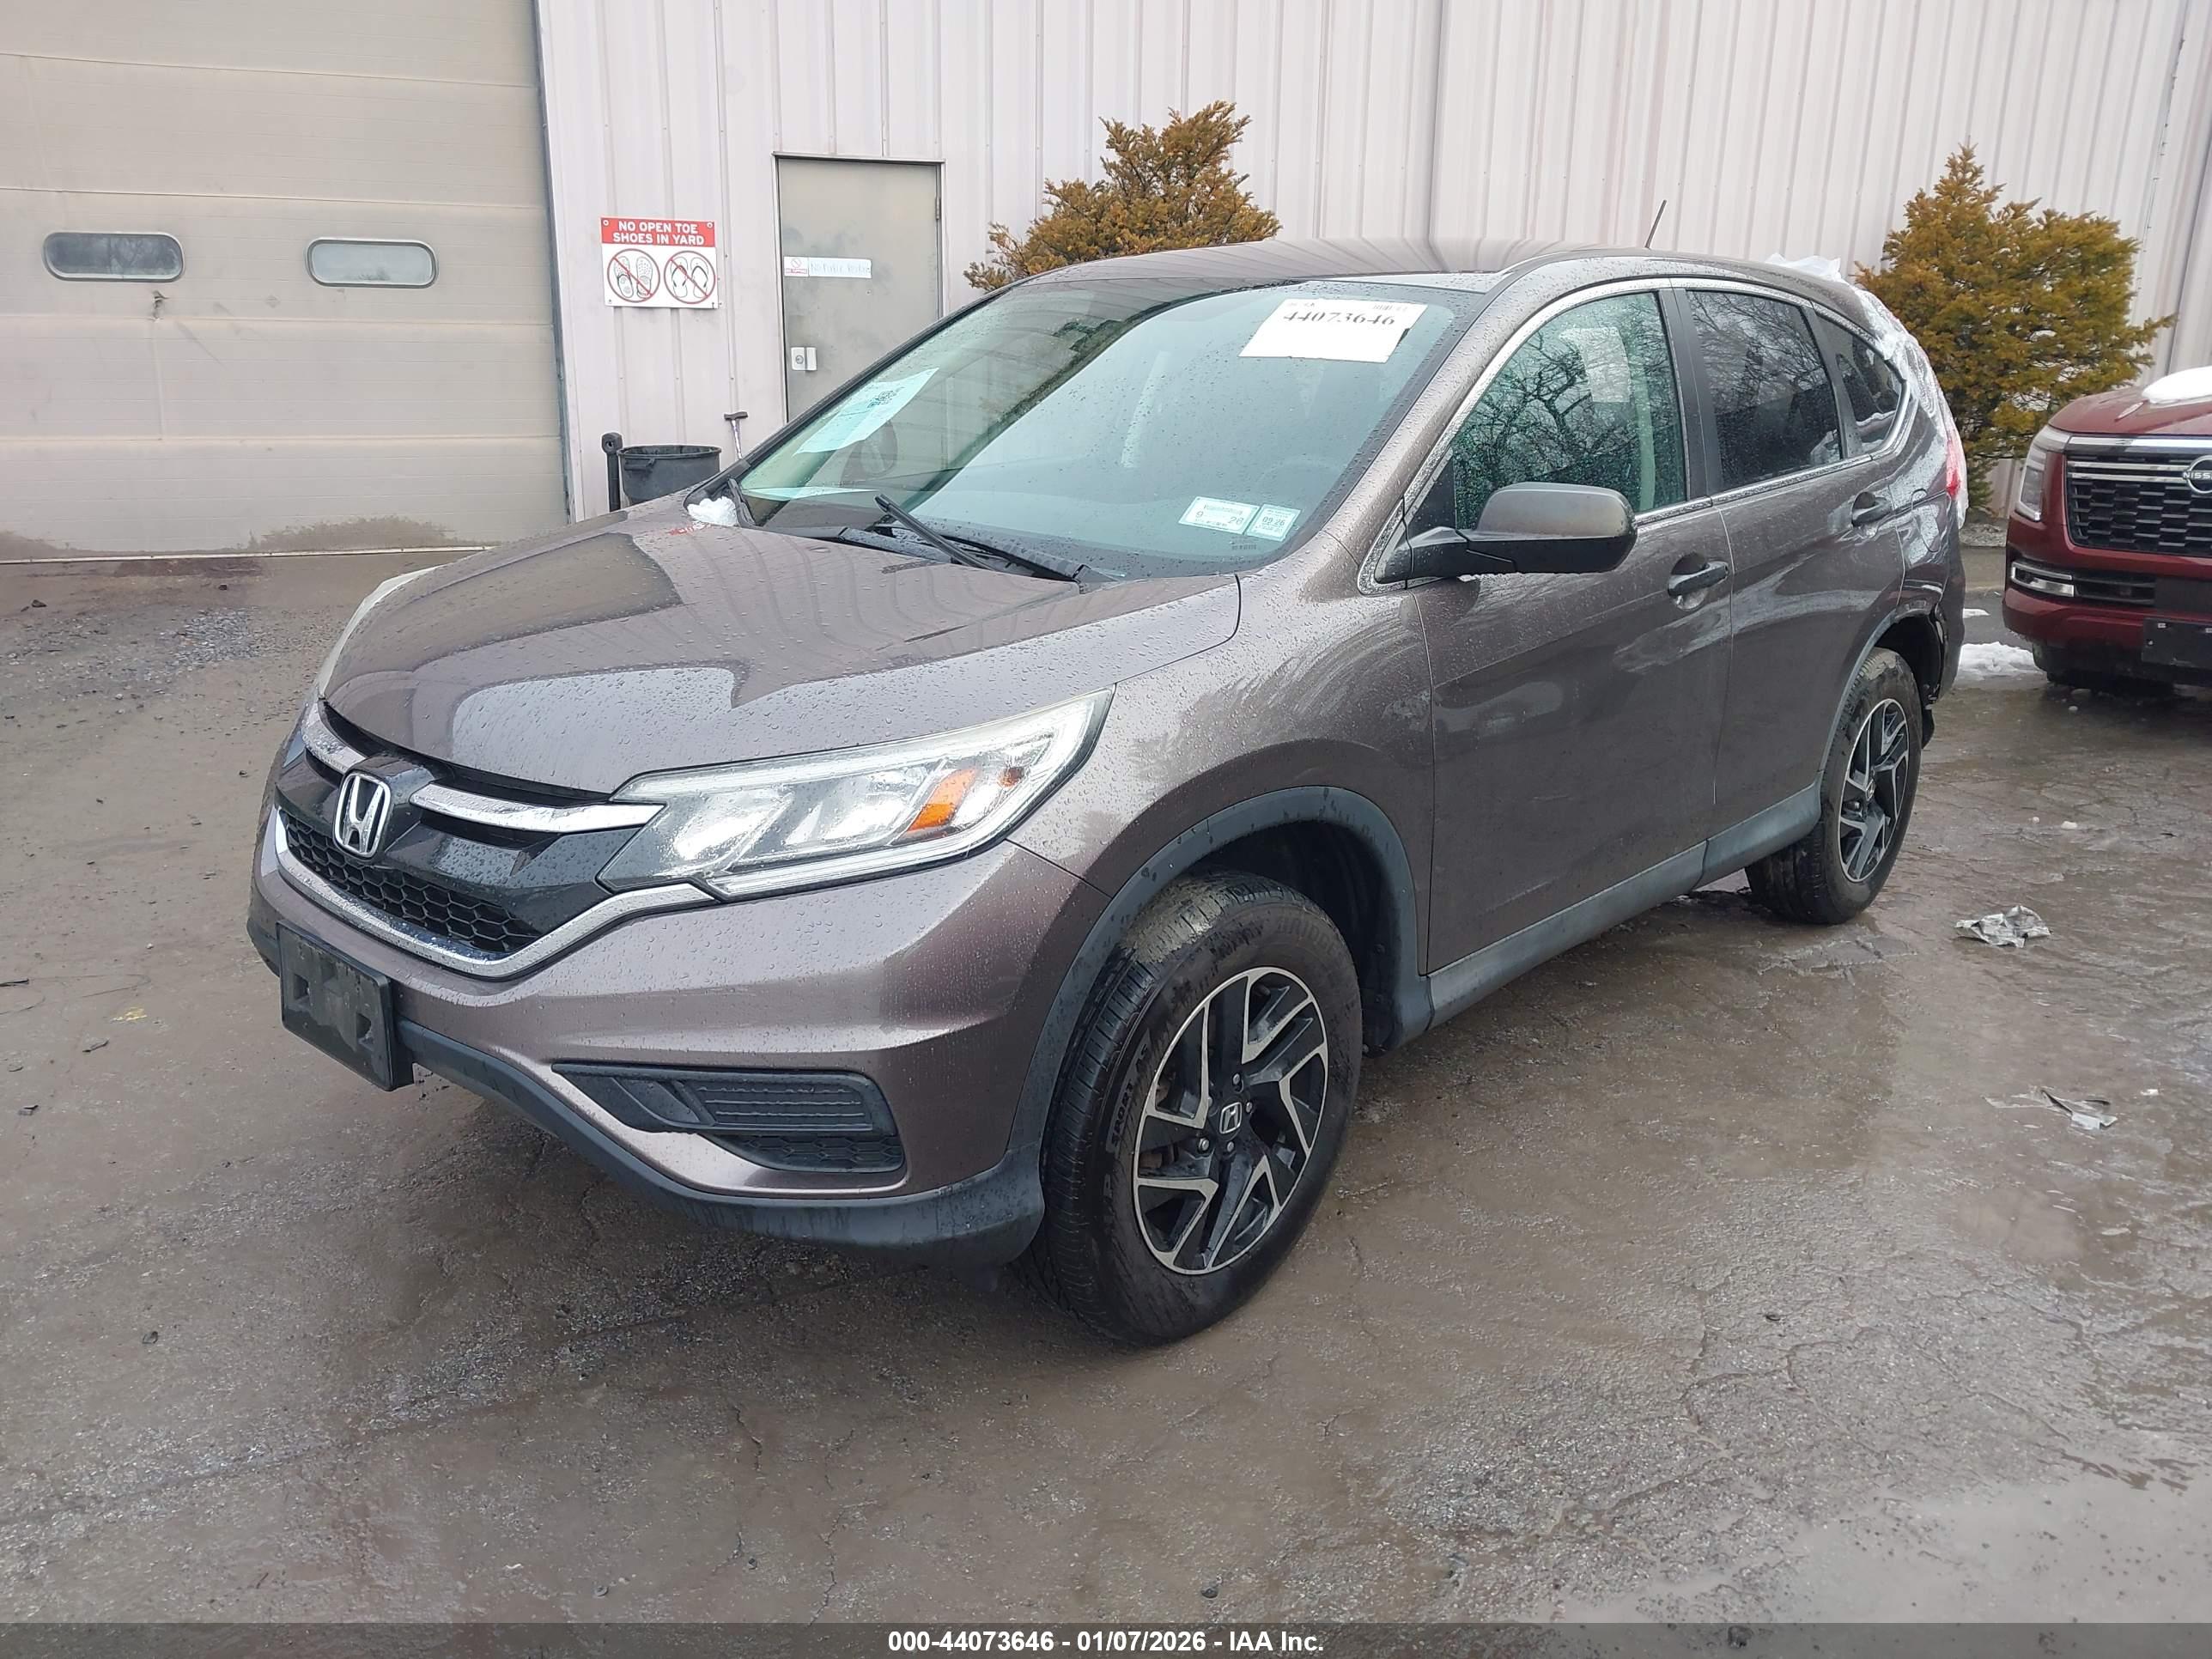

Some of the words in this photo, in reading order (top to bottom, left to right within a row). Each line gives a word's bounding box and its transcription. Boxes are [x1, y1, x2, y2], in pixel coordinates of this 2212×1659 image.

[618, 221, 636, 232] NO
[639, 222, 672, 234] OPEN
[674, 223, 698, 234] TOE
[613, 233, 653, 244] SHOES
[657, 234, 669, 244] IN
[672, 234, 704, 246] YARD
[1283, 311, 1395, 326] 44073646
